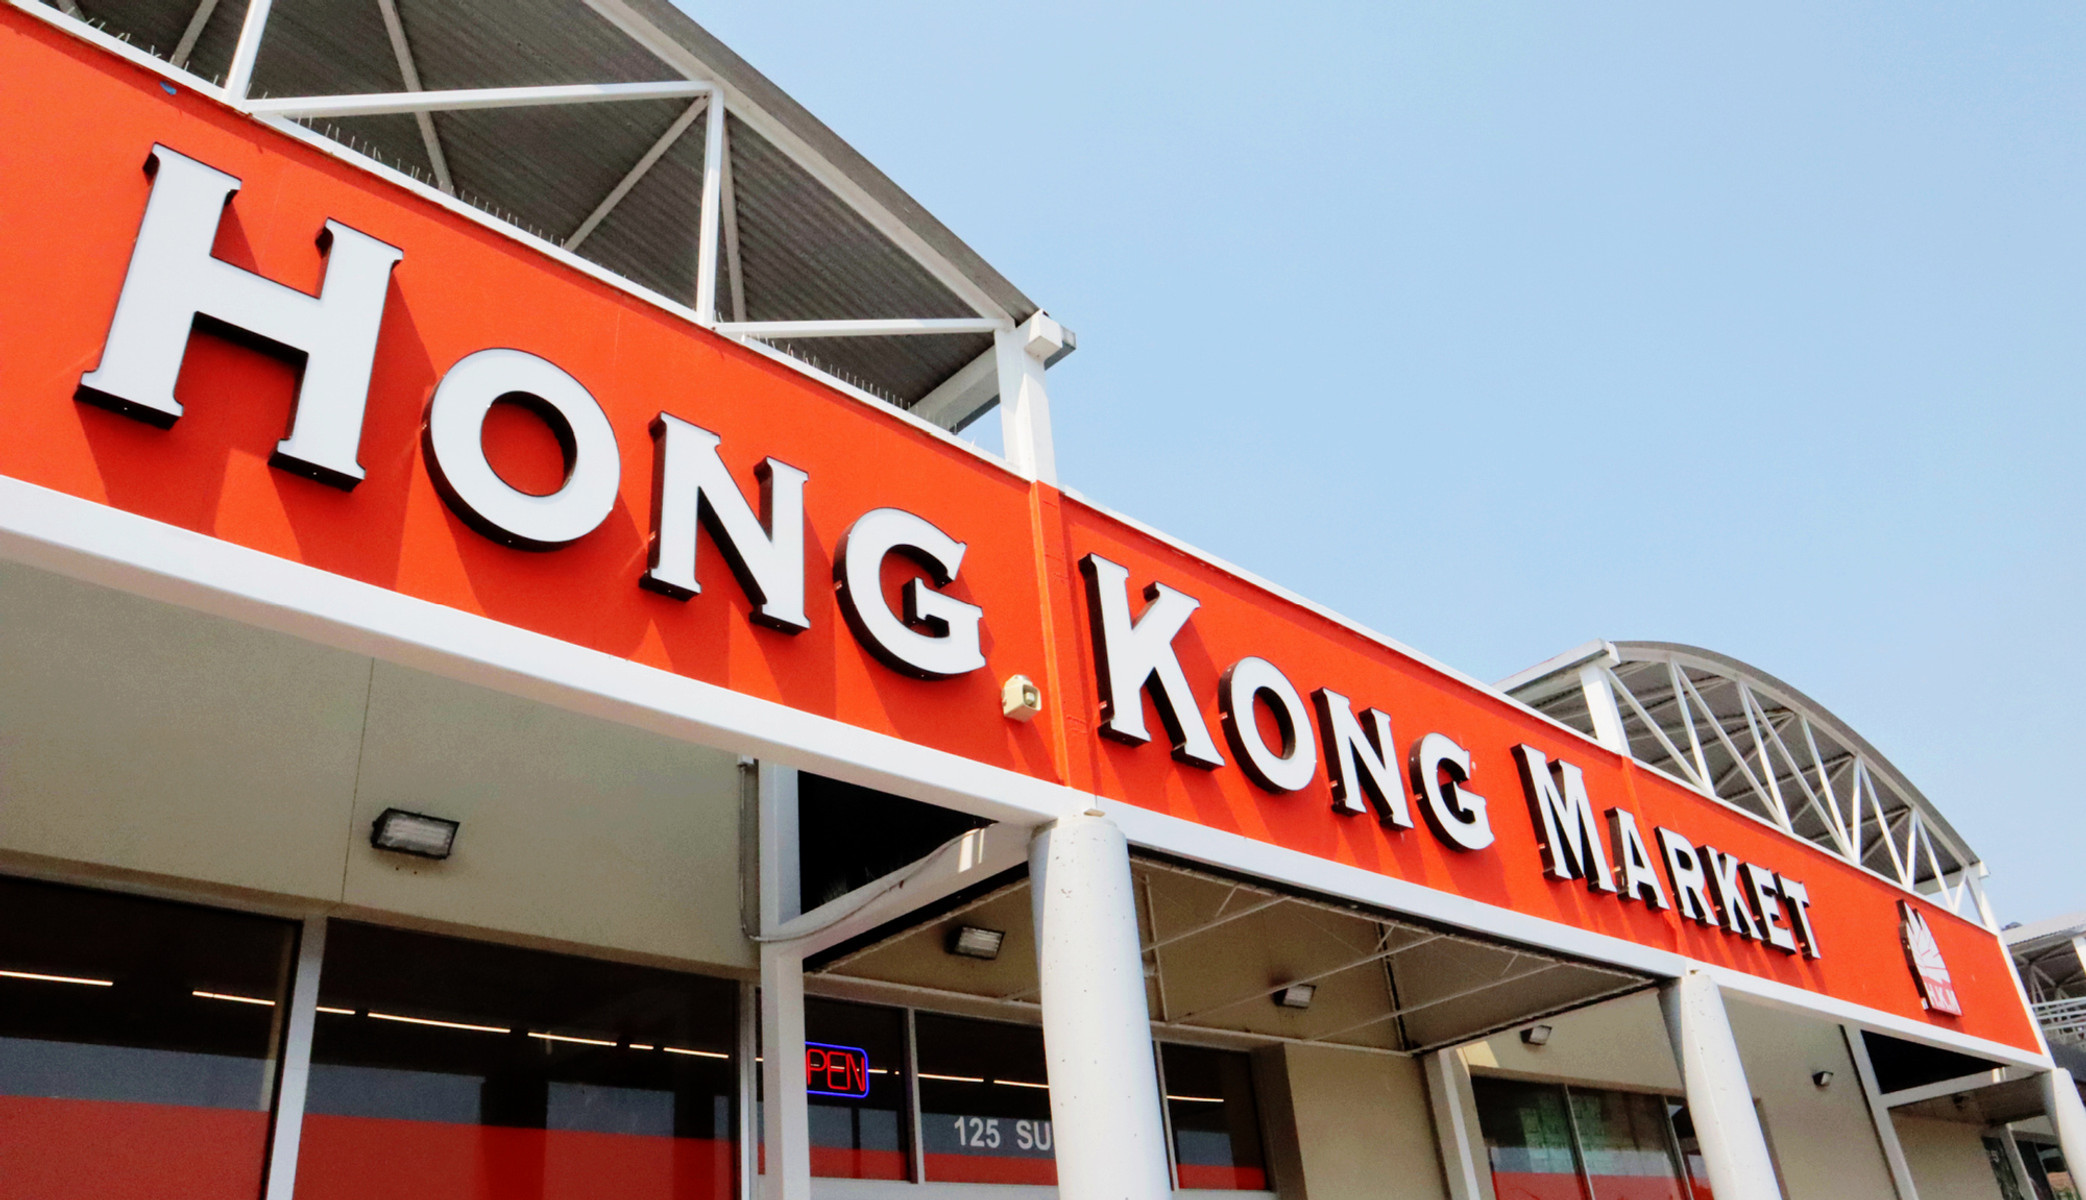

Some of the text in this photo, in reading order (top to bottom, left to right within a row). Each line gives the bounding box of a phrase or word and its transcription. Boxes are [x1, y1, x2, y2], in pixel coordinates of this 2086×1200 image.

[75, 142, 1822, 959] HONG KONG MARKET
[806, 1048, 866, 1091] PEN
[954, 1116, 1000, 1148] 125
